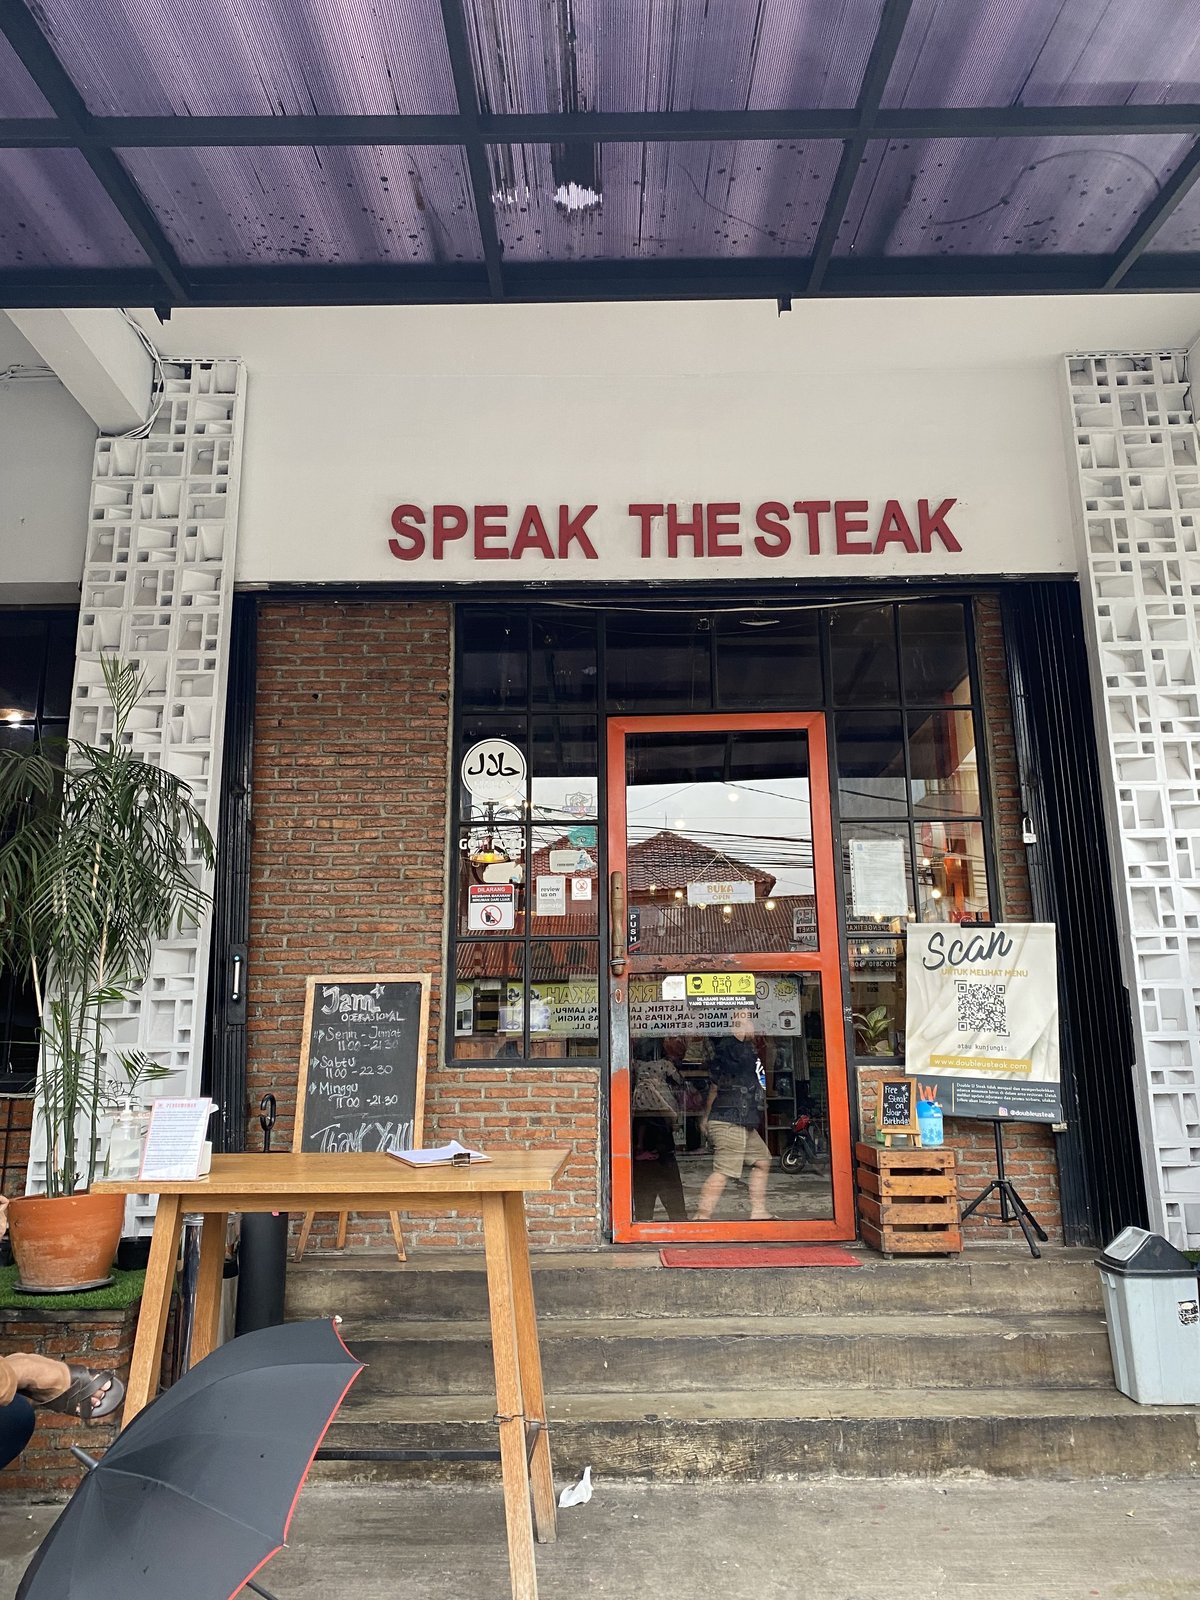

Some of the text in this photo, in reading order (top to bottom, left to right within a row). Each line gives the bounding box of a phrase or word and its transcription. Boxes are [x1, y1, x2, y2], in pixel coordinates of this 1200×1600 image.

[388, 498, 963, 561] SPEAK THE STEAK
[467, 752, 520, 777] حلال
[707, 885, 734, 893] BUKA
[923, 931, 1013, 970] Scan
[941, 968, 1028, 977] UNTUK MELIHAT MENU
[321, 986, 381, 1014] Jam
[325, 1027, 358, 1041] Senin
[975, 1044, 1007, 1052] kunjungi:
[320, 1055, 356, 1068] Sabtu
[934, 1058, 1028, 1070] www.doubleusteak.com
[319, 1082, 359, 1099] Minggu
[884, 1085, 898, 1094] Free
[885, 1108, 902, 1116] Your
[1010, 1109, 1055, 1118] @doubleusteak
